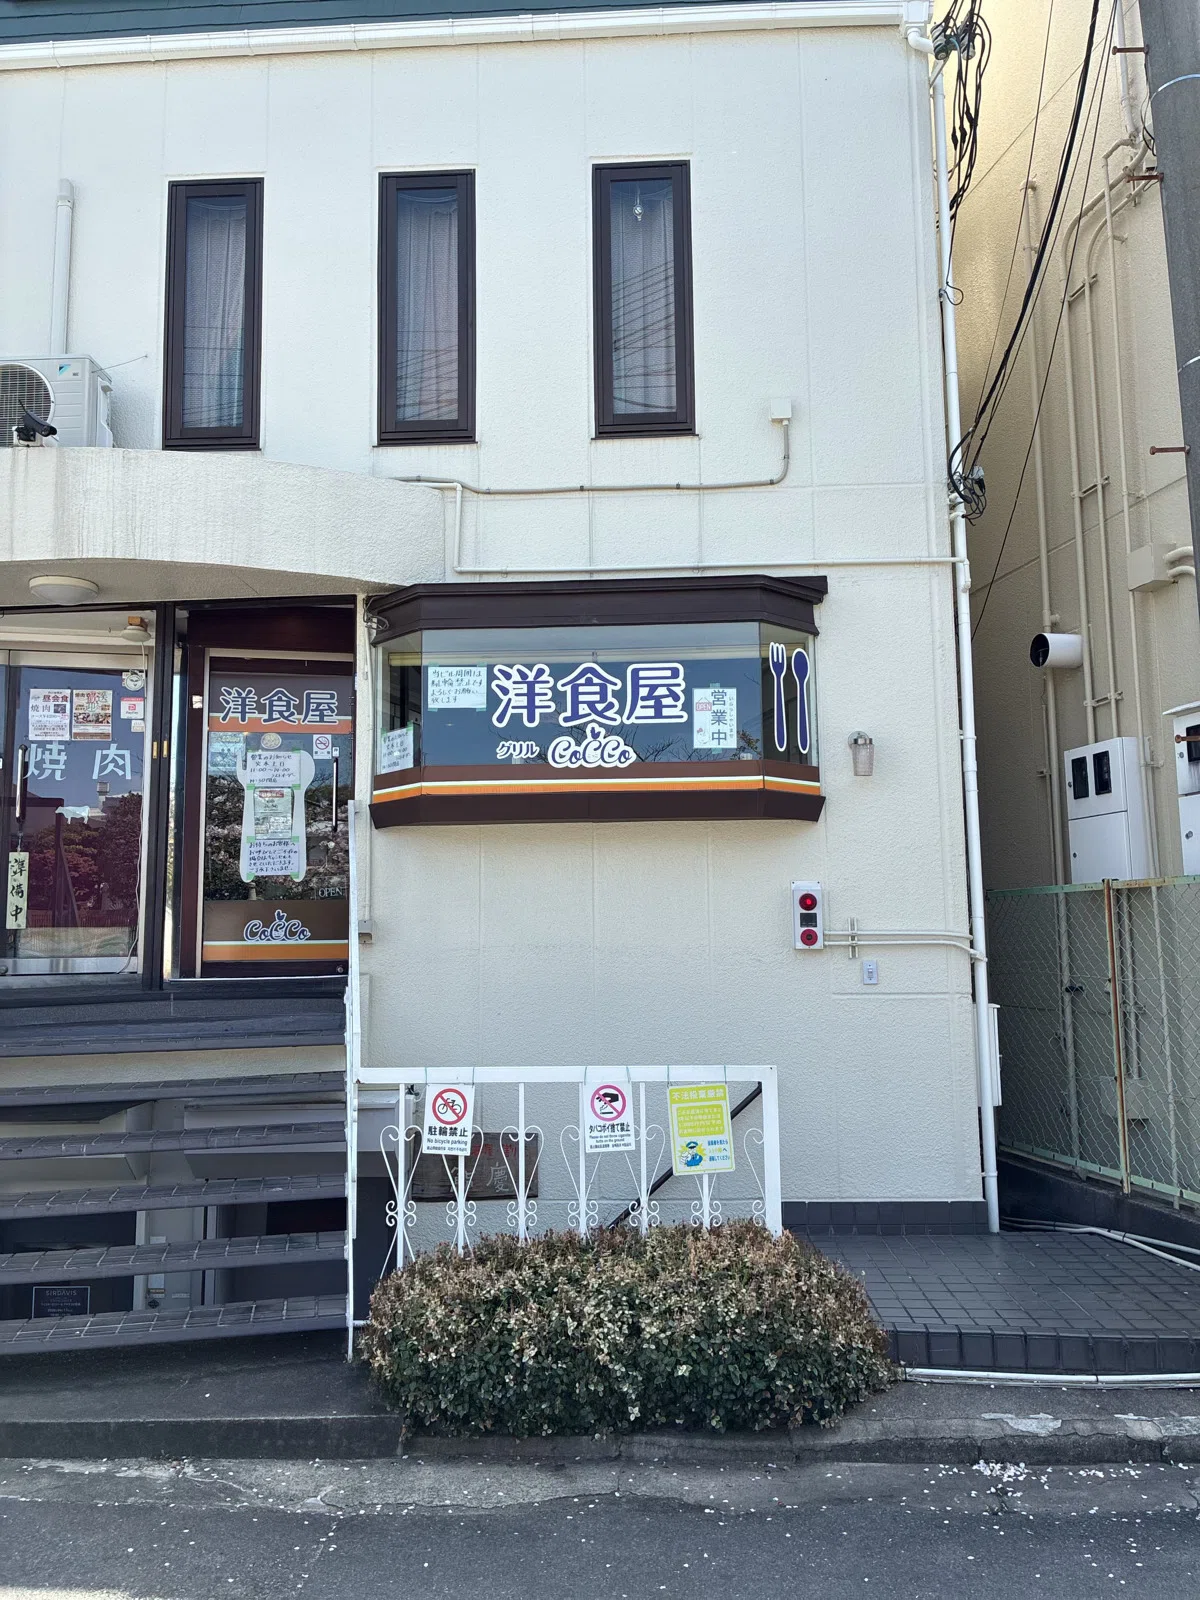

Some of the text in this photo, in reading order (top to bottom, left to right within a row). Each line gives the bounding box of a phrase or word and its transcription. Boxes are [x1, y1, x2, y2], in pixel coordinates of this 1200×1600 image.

[42, 694, 69, 703] 昼会食
[491, 662, 688, 727] 洋食屋
[31, 704, 51, 712] 焼肉
[220, 687, 338, 724] 洋食屋
[696, 702, 712, 711] OPEN
[711, 689, 727, 746] 営業中
[497, 741, 539, 759] グリル
[24, 740, 132, 781] 焼肉
[318, 887, 343, 898] OPEN
[672, 1089, 724, 1101] 不法投棄厳禁
[428, 1126, 468, 1137] 駐輪禁止
[589, 1122, 631, 1133] タバコポイ捨て禁止
